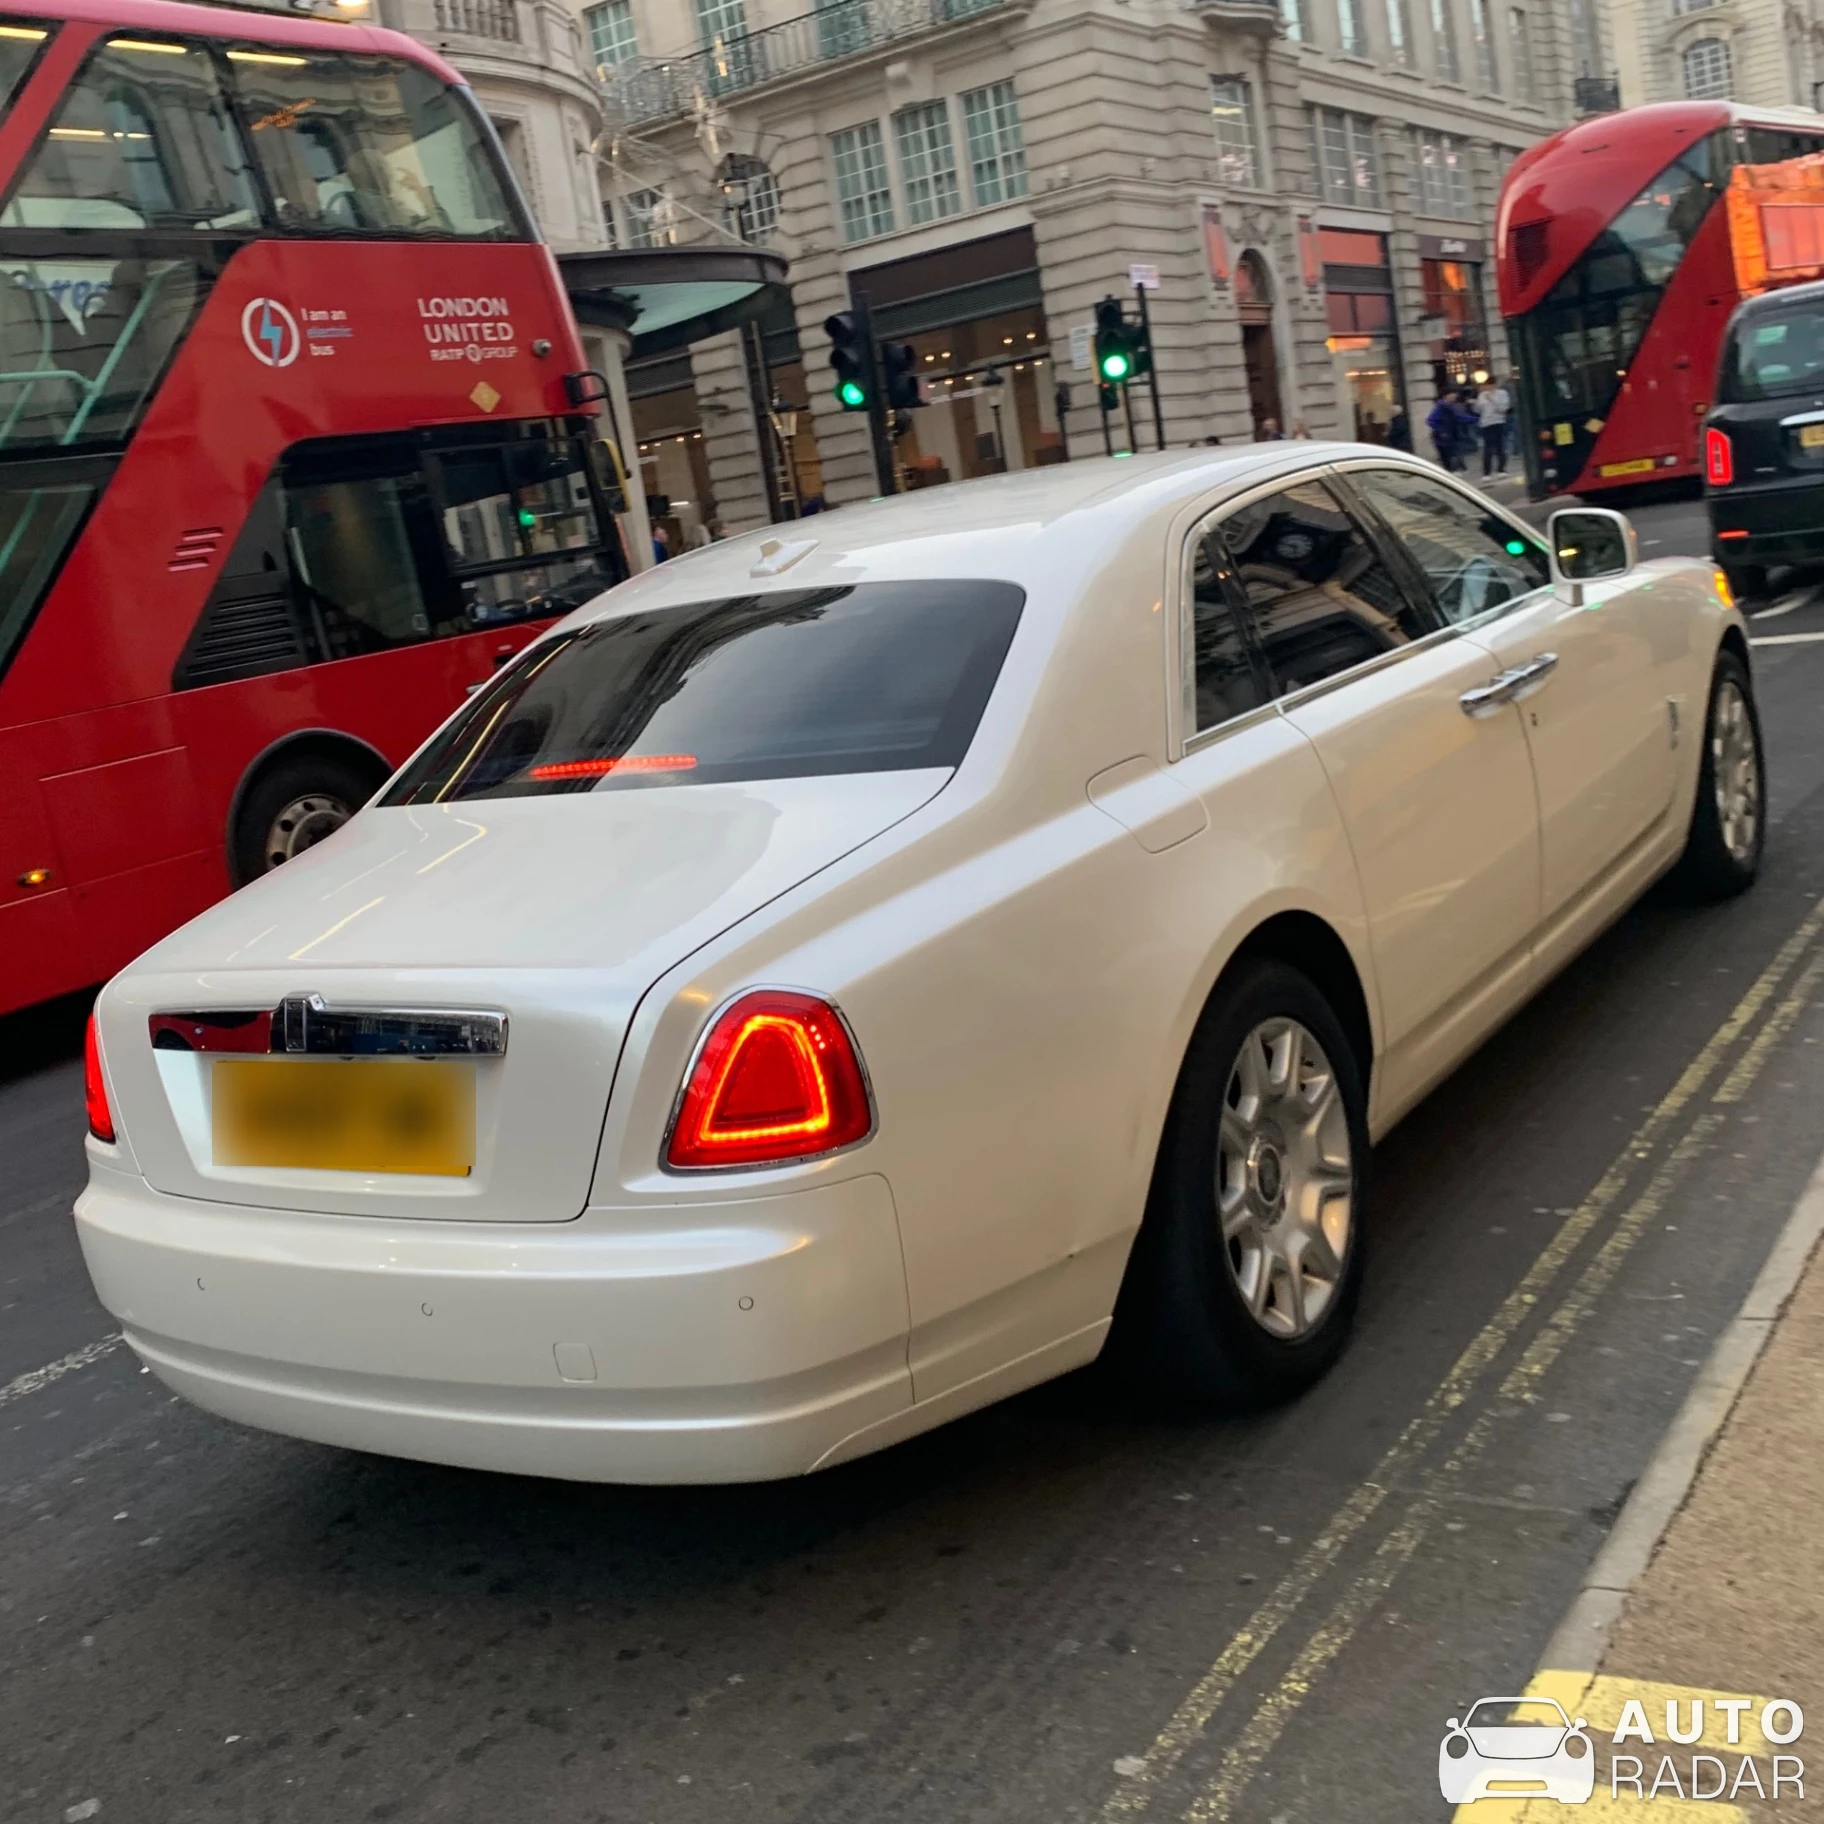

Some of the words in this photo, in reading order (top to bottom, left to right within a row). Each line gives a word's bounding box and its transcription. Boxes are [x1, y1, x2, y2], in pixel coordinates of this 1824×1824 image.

[301, 308, 308, 321] I
[417, 297, 509, 318] LONDON
[423, 322, 514, 343] UNITED
[309, 343, 335, 356] bus
